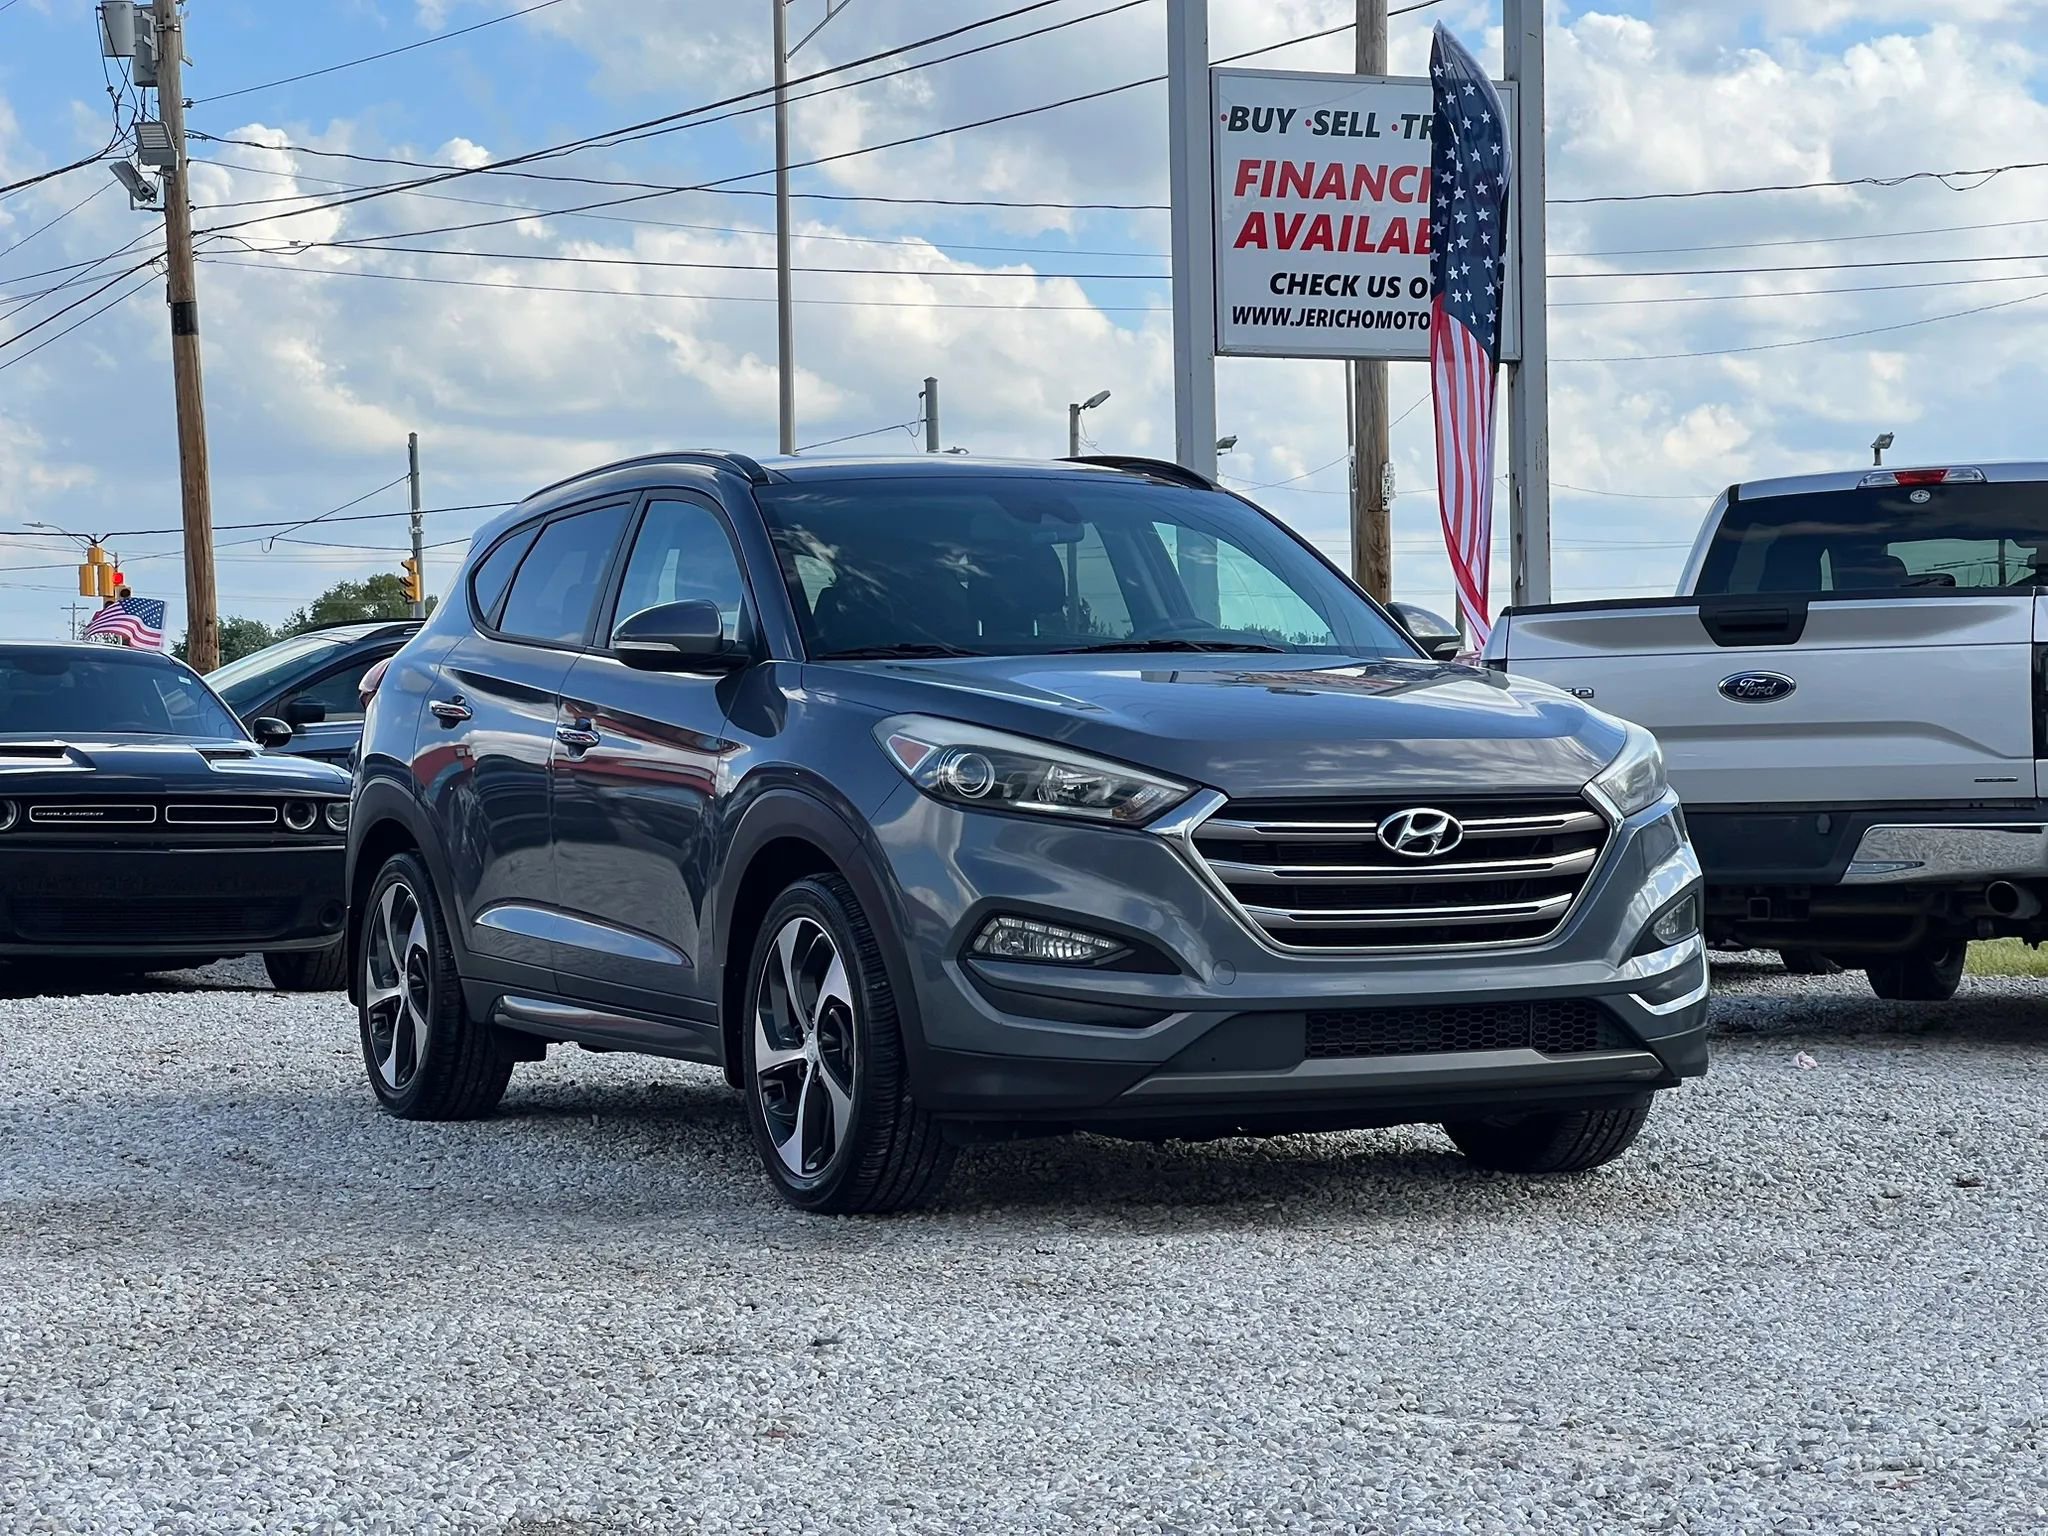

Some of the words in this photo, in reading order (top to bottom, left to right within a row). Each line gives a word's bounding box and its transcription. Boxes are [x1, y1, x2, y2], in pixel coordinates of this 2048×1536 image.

[1227, 105, 1297, 134] BUY
[1312, 109, 1380, 138] SELL
[1269, 272, 1361, 297] CHECK
[1367, 275, 1401, 299] US
[1735, 677, 1778, 697] Ford
